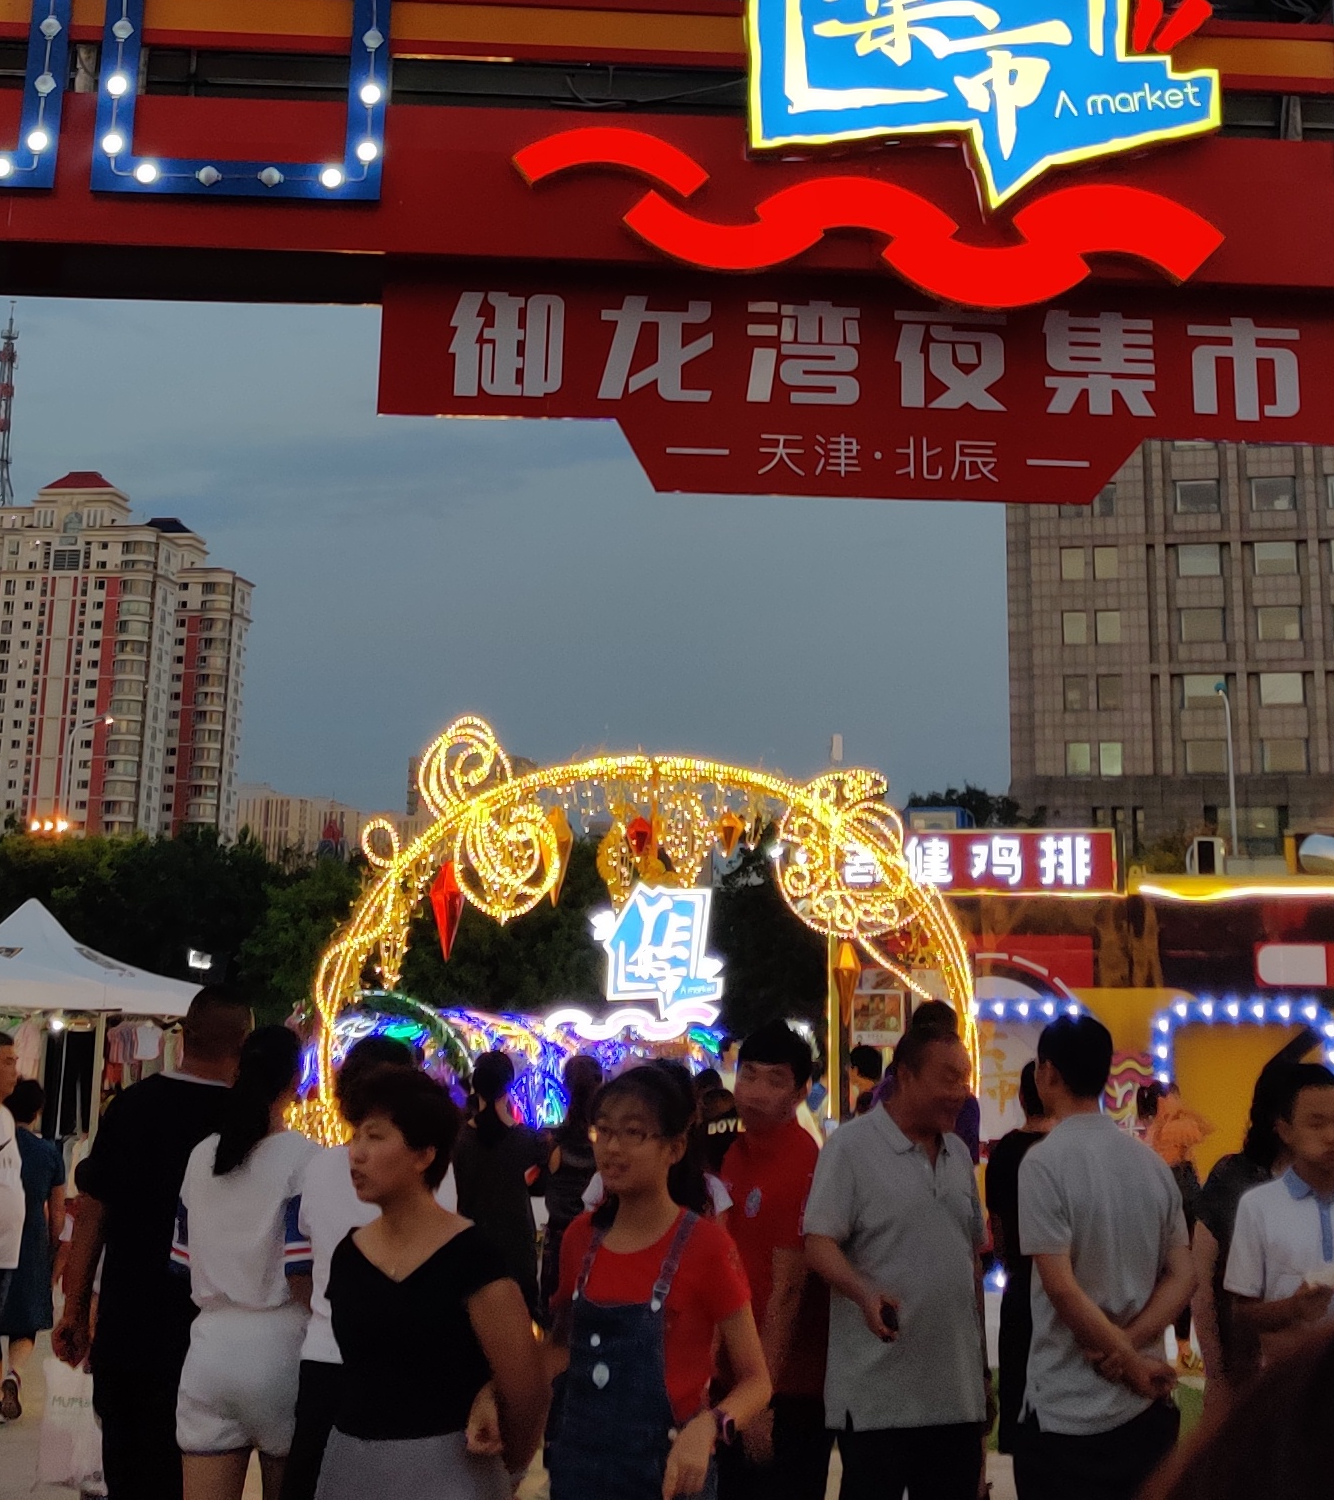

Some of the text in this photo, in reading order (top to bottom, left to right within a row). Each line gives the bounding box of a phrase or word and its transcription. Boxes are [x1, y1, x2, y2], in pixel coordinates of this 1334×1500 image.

[1086, 82, 1201, 116] market
[448, 291, 1300, 421] 御龙湾夜集市
